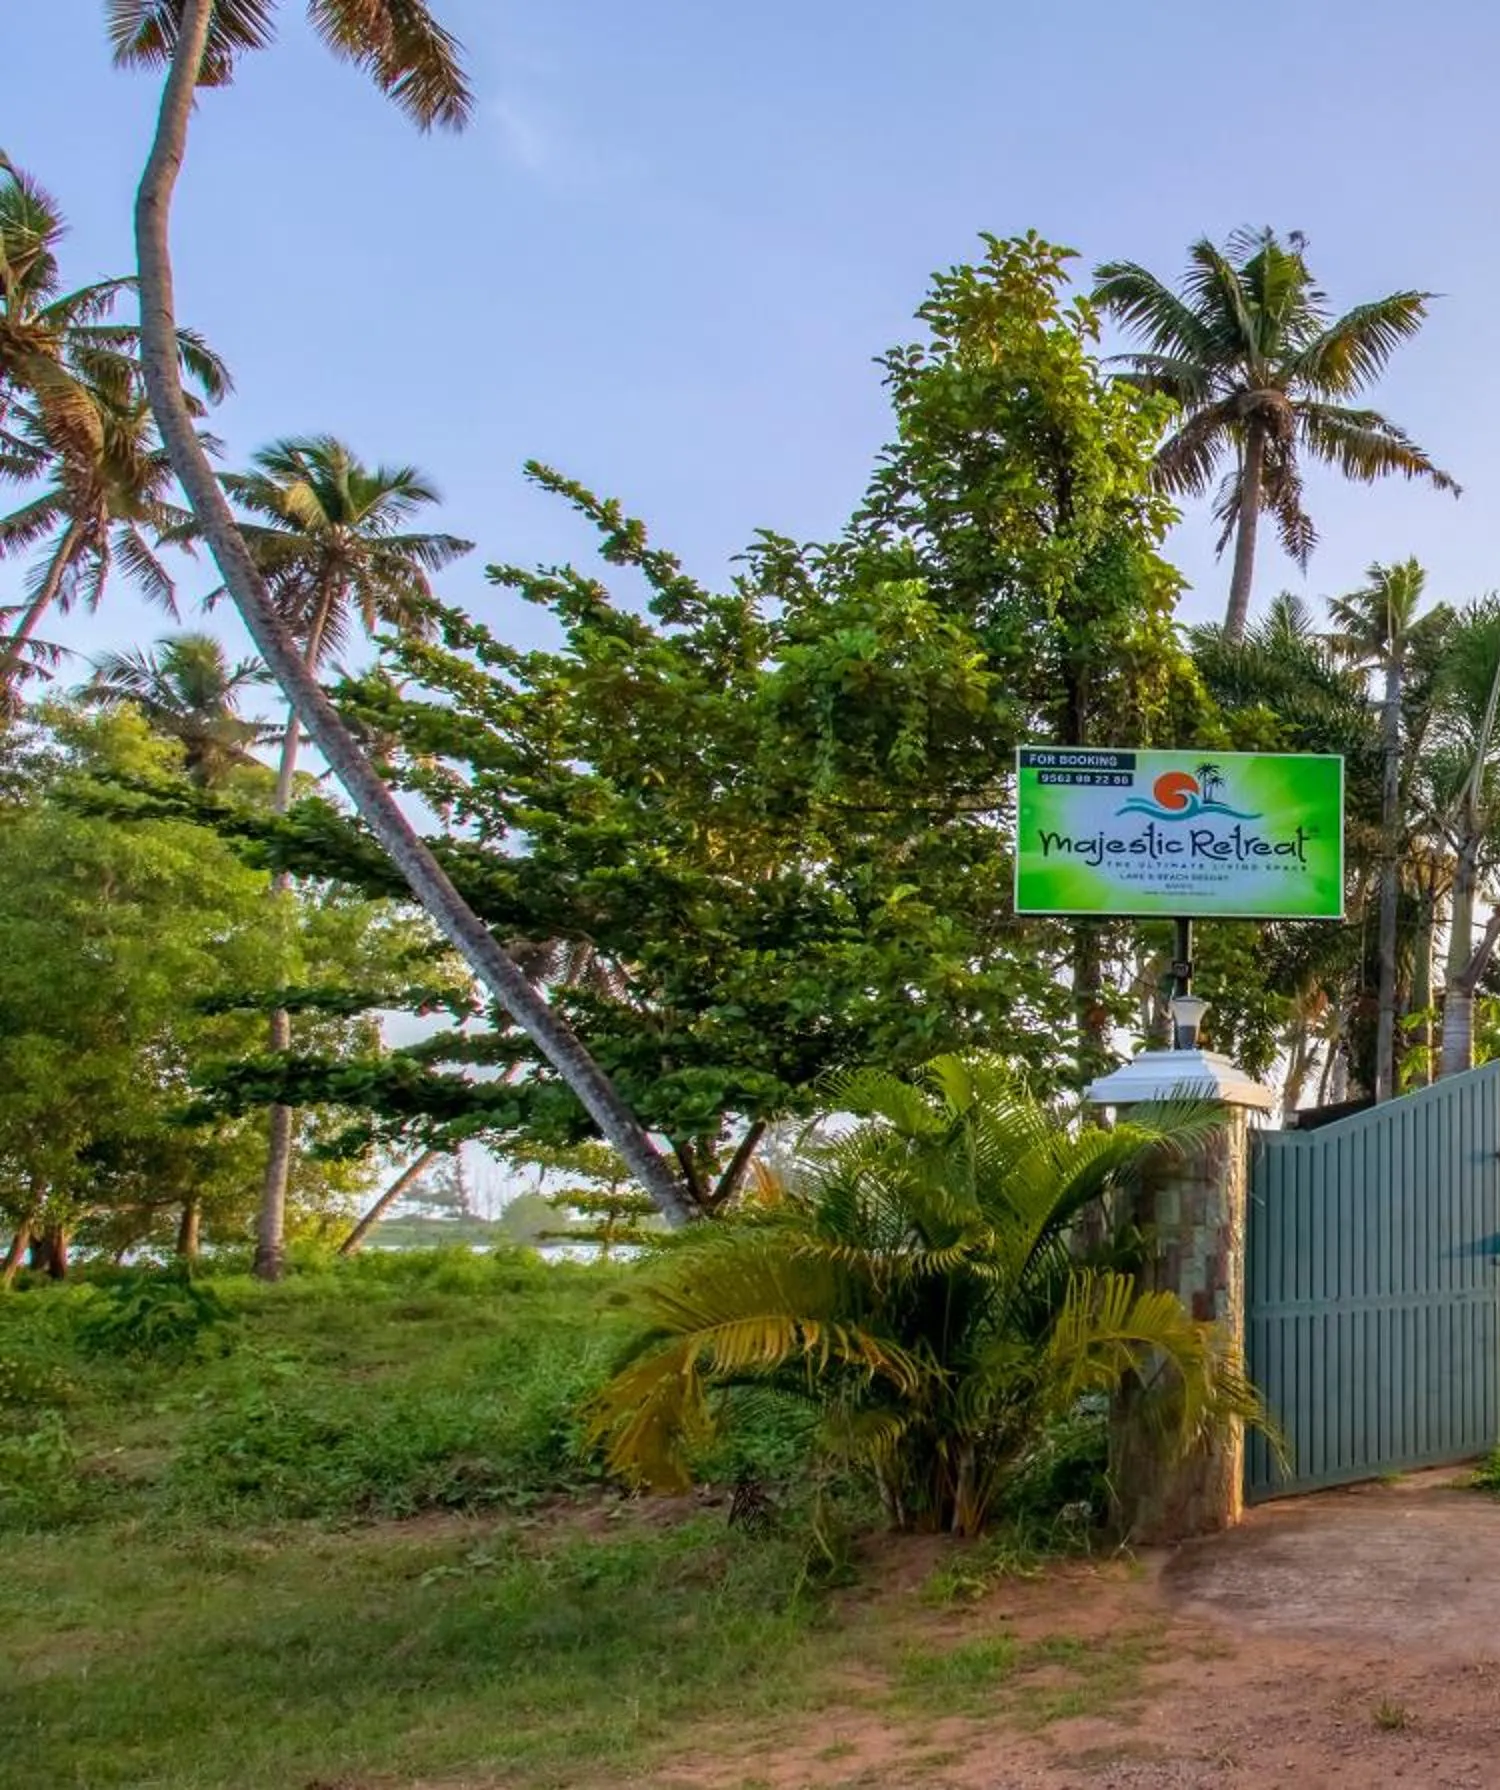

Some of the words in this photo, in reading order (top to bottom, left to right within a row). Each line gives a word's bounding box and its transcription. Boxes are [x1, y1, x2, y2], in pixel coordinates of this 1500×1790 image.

[1029, 754, 1056, 765] FOR
[1059, 755, 1118, 767] BOOKING
[1190, 824, 1311, 863] Retreat
